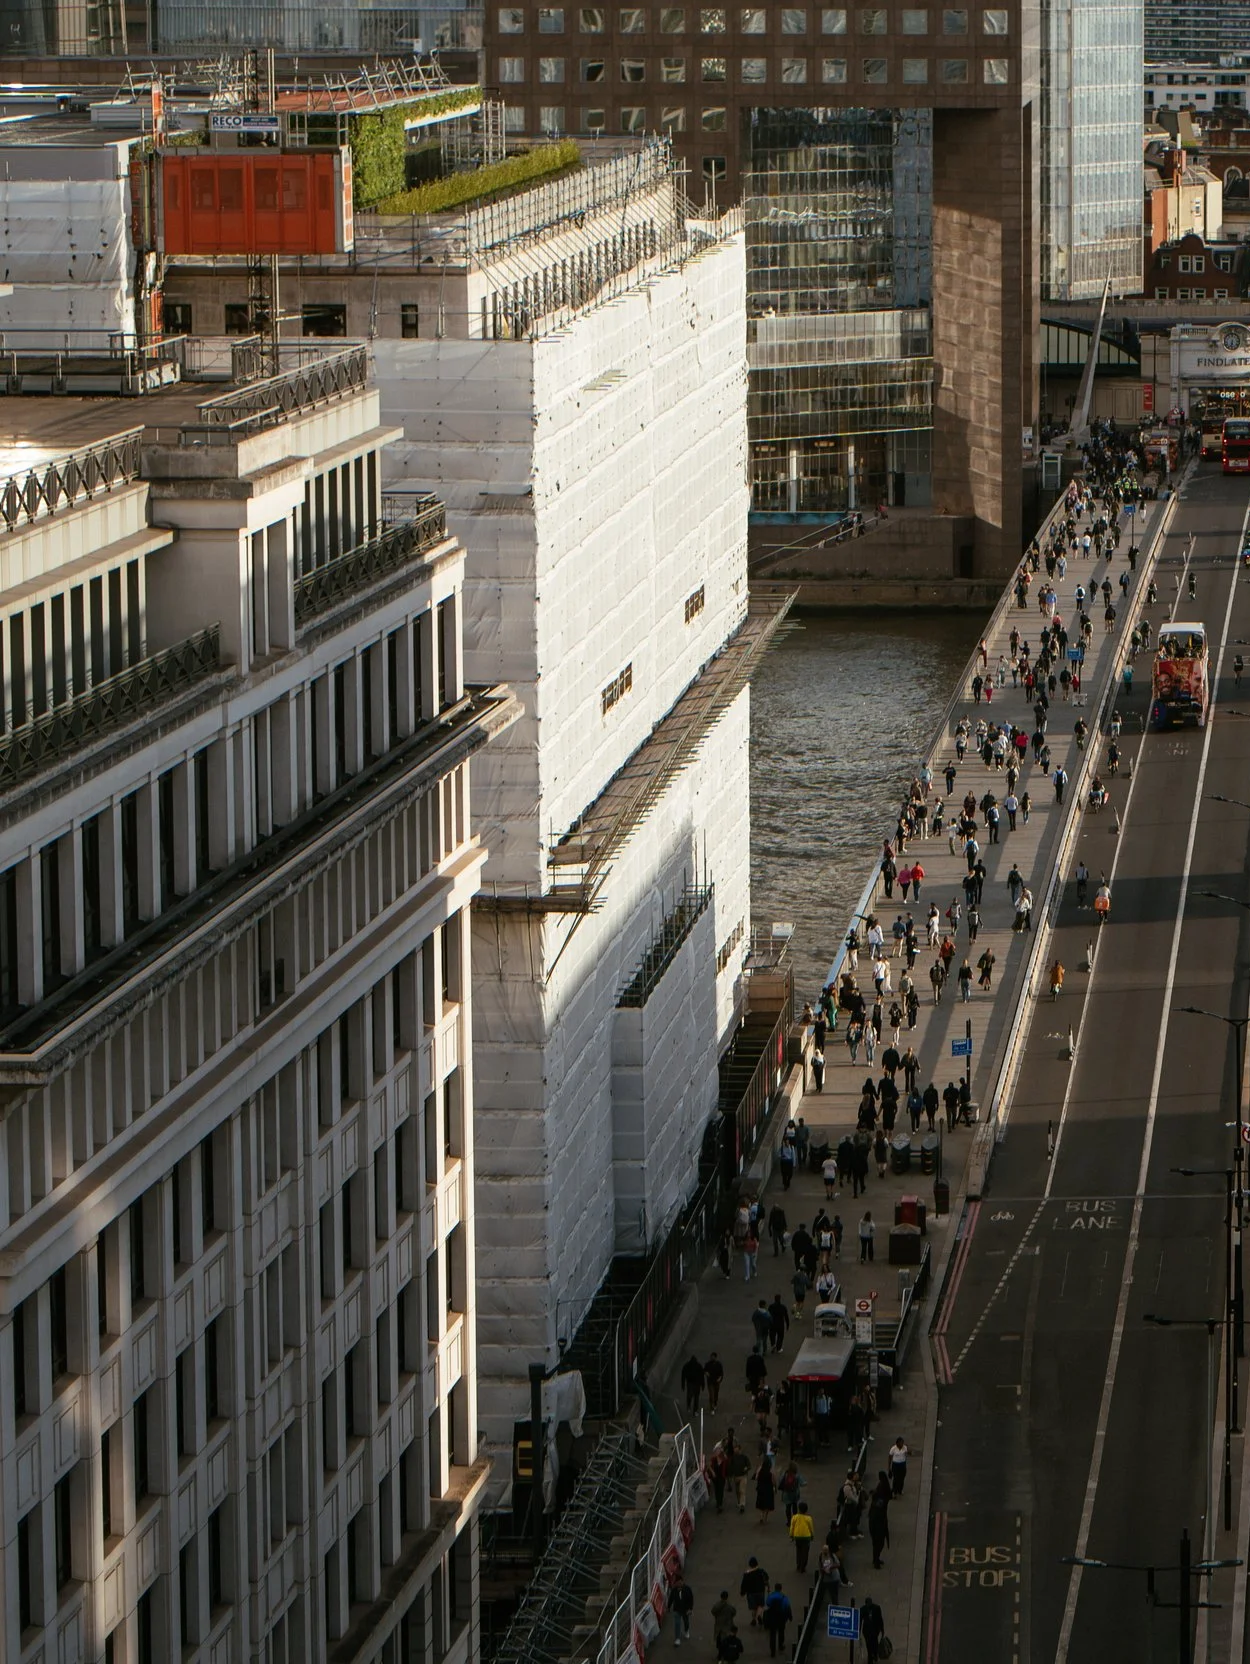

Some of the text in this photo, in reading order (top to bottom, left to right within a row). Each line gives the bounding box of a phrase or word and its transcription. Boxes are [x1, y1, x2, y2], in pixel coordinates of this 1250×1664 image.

[212, 116, 241, 126] RECO
[1065, 1200, 1117, 1212] BUS
[1052, 1216, 1123, 1230] LANE
[949, 1546, 1012, 1565] BUS
[942, 1569, 1017, 1588] STOP
